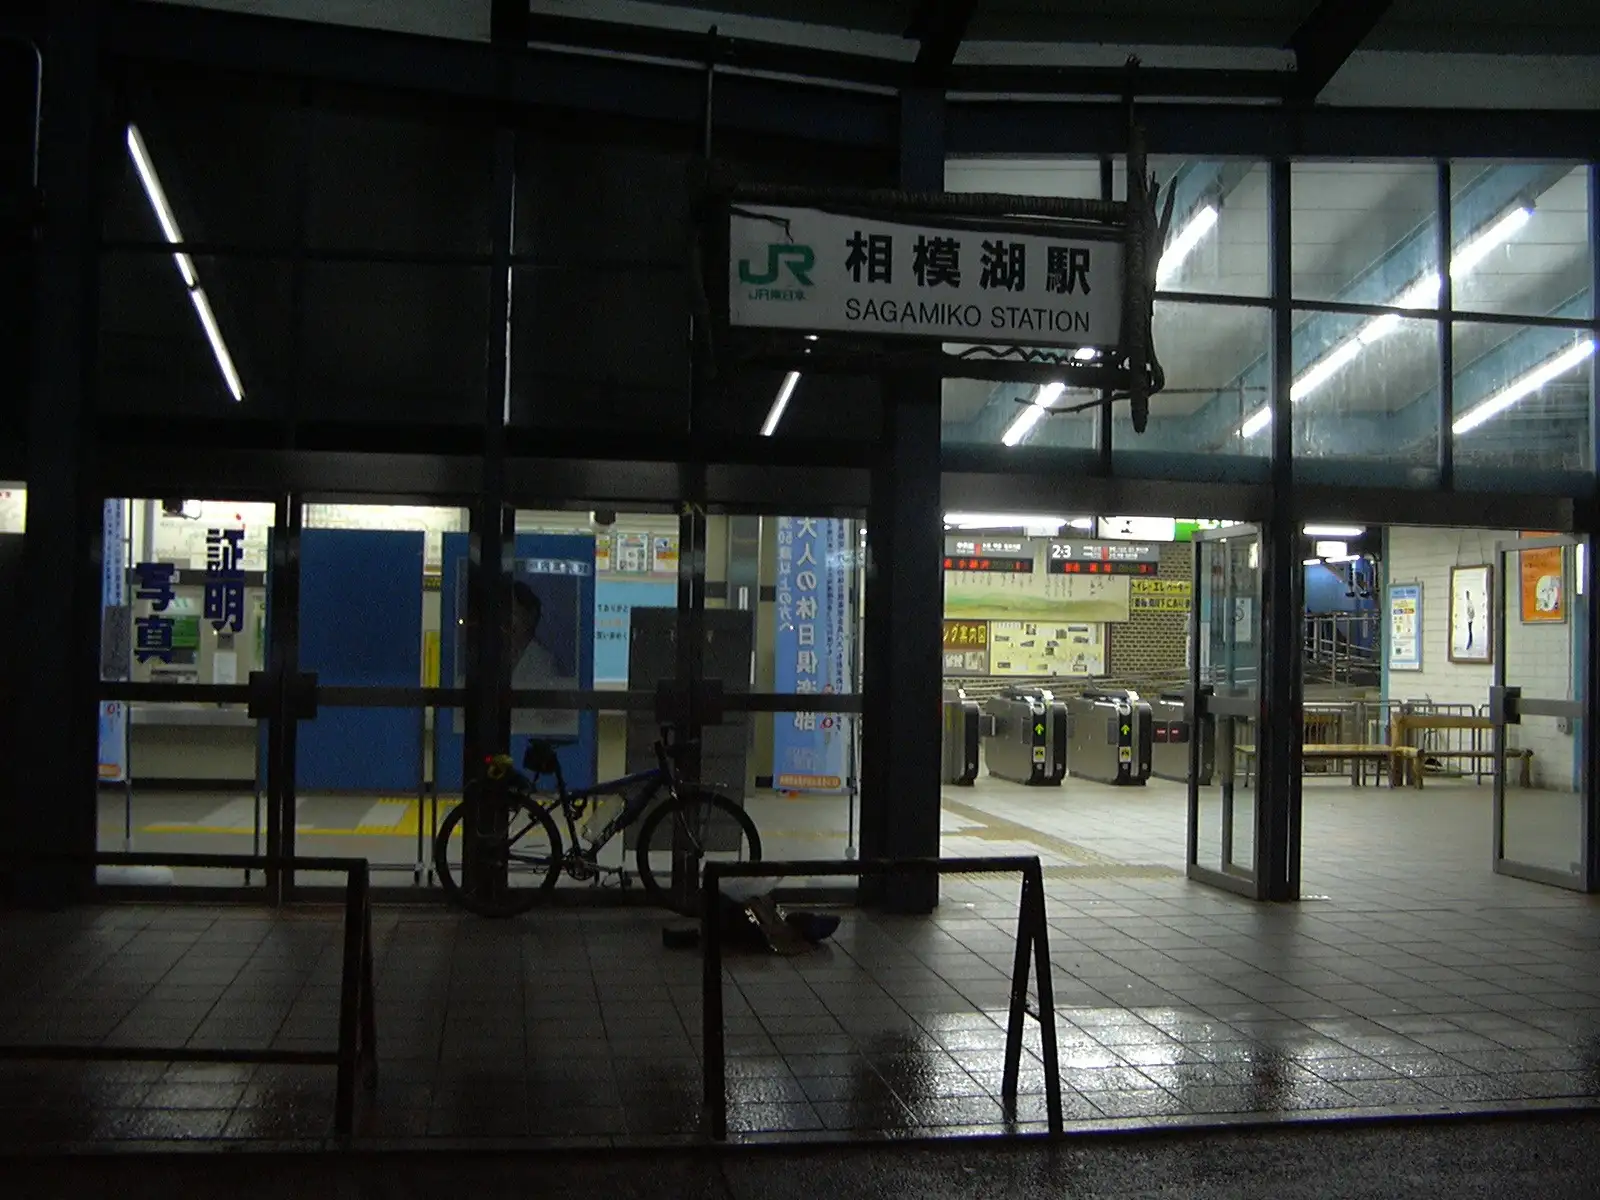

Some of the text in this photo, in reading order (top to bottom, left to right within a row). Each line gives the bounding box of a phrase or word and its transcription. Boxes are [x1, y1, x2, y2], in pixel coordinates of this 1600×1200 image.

[738, 244, 816, 287] JR
[844, 230, 1092, 296] 相模湖駅
[845, 298, 1091, 333] SAGAMIKO STATION
[134, 562, 176, 664] 写真
[203, 528, 246, 633] 証明
